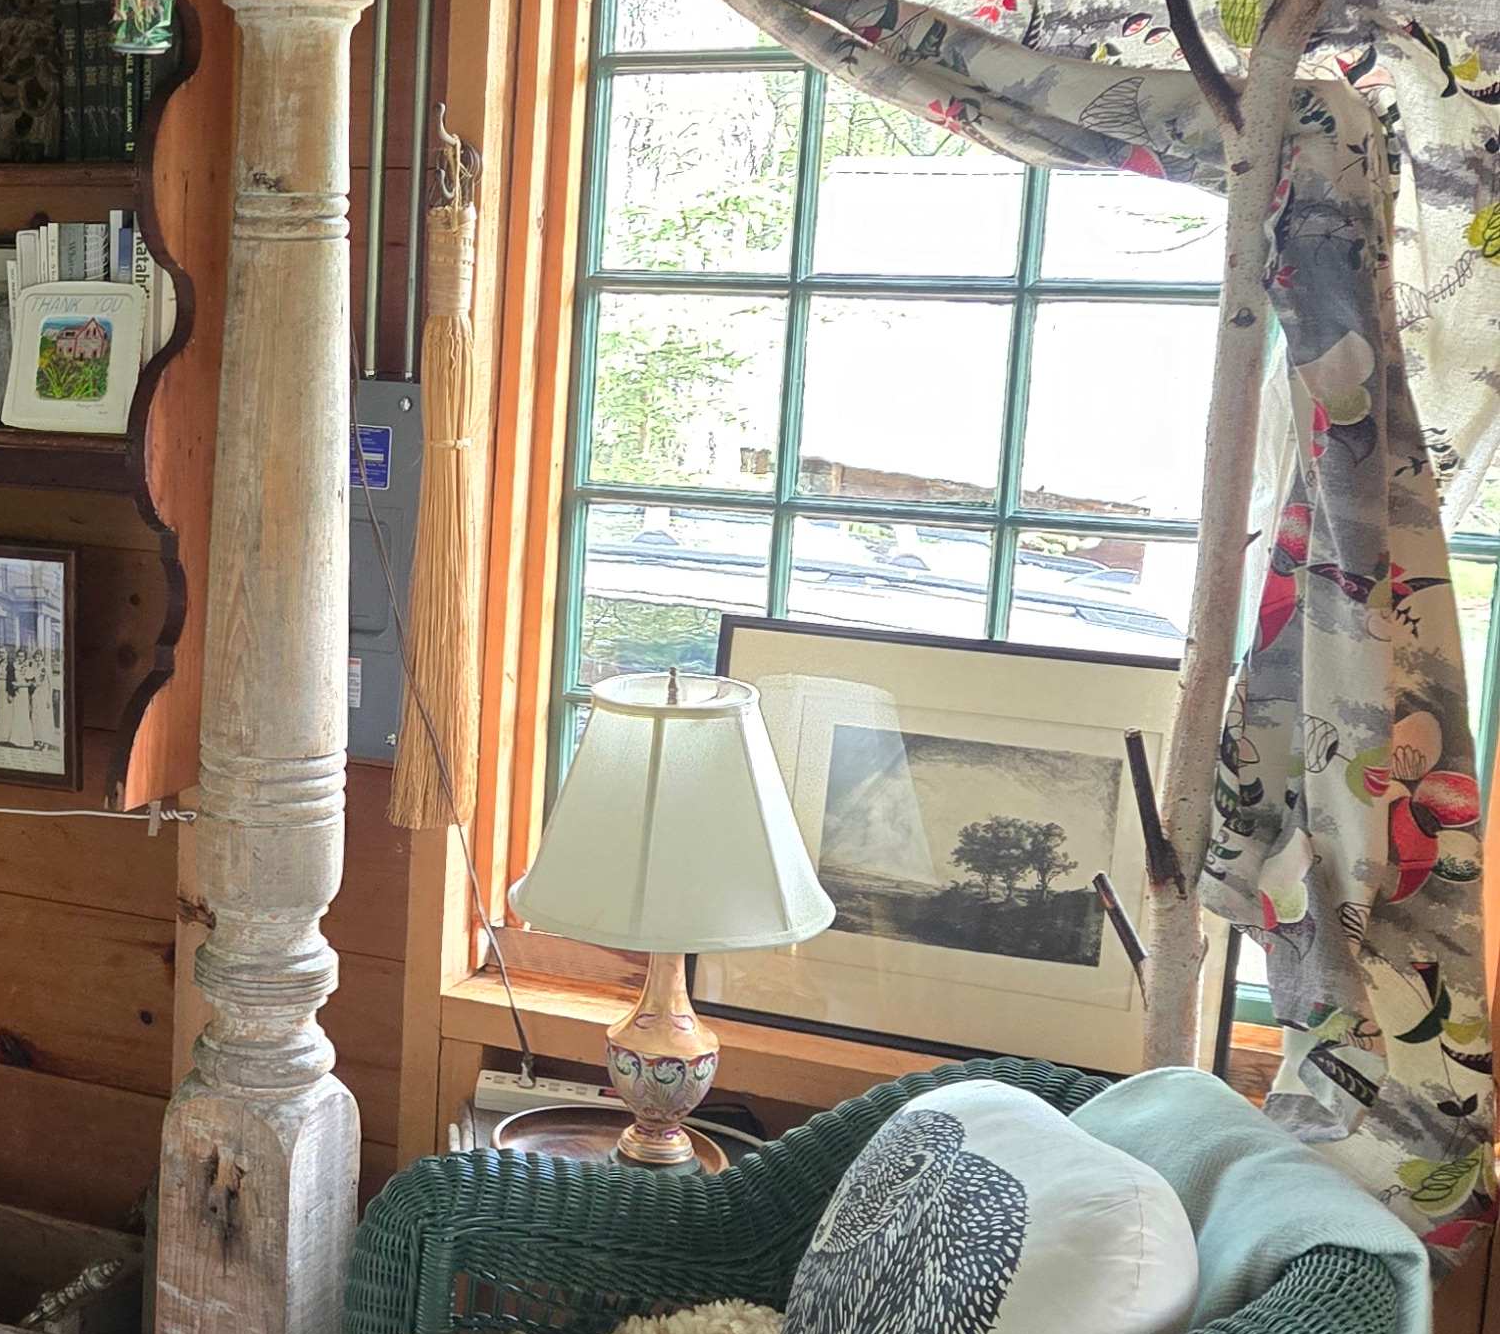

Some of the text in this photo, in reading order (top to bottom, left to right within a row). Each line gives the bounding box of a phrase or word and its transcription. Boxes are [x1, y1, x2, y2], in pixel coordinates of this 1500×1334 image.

[134, 234, 151, 300] Katah
[30, 296, 124, 314] THANK YOU
